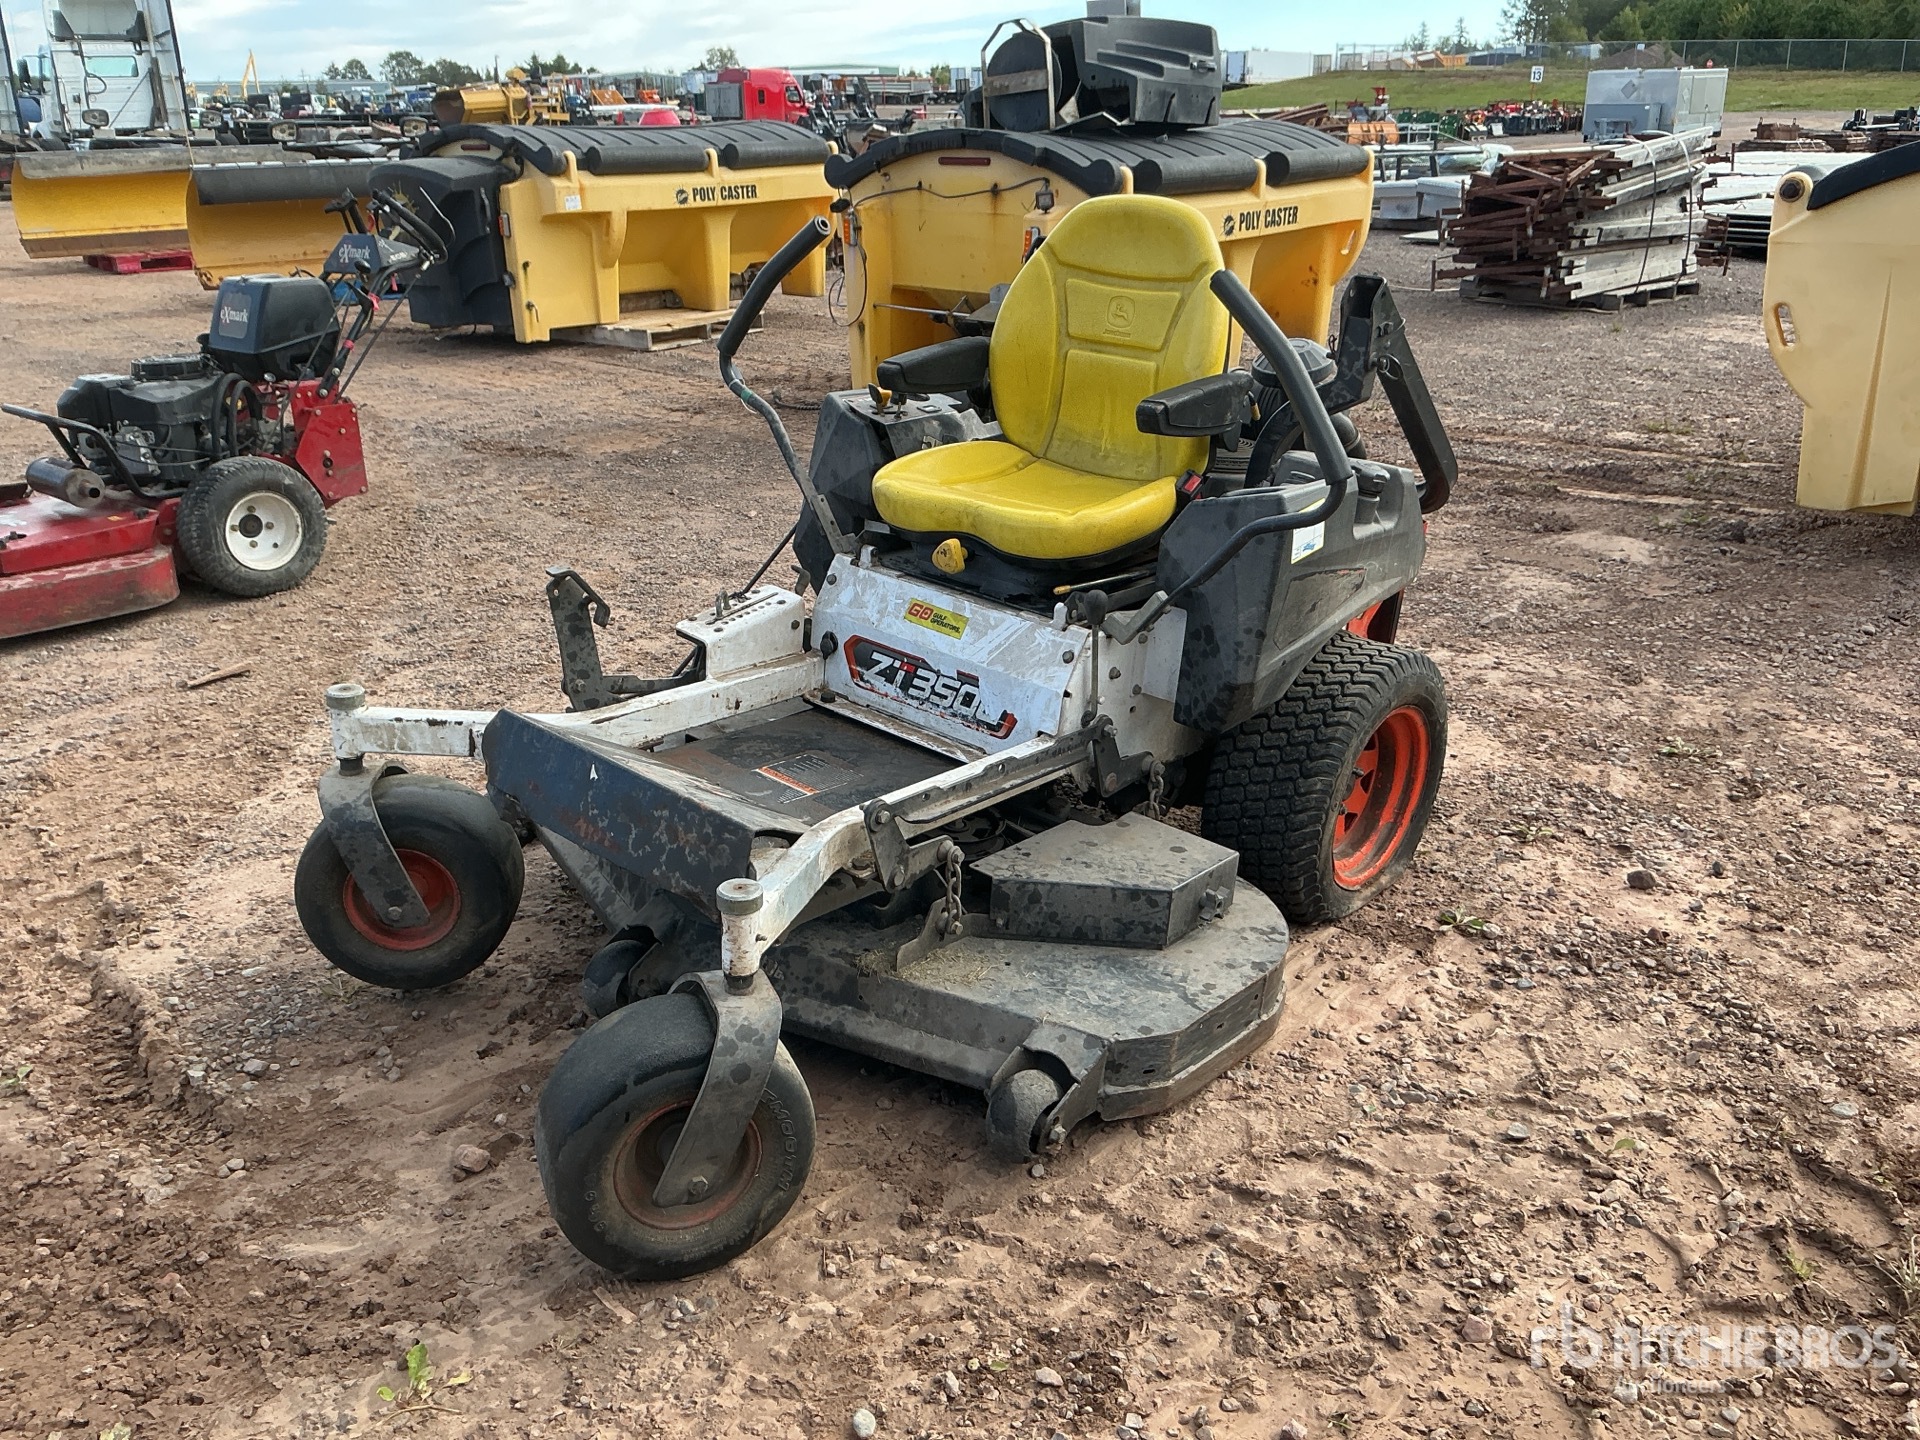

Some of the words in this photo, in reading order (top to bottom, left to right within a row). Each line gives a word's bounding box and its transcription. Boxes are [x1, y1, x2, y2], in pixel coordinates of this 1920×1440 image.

[1532, 70, 1542, 81] 13
[692, 185, 716, 202] POLY
[720, 184, 757, 201] CASTER
[1239, 210, 1261, 232] POLY
[1264, 205, 1299, 228] CASTER
[338, 243, 371, 263] eXmark
[220, 305, 248, 324] eXmark
[908, 603, 934, 620] GO
[932, 612, 947, 621] GULF
